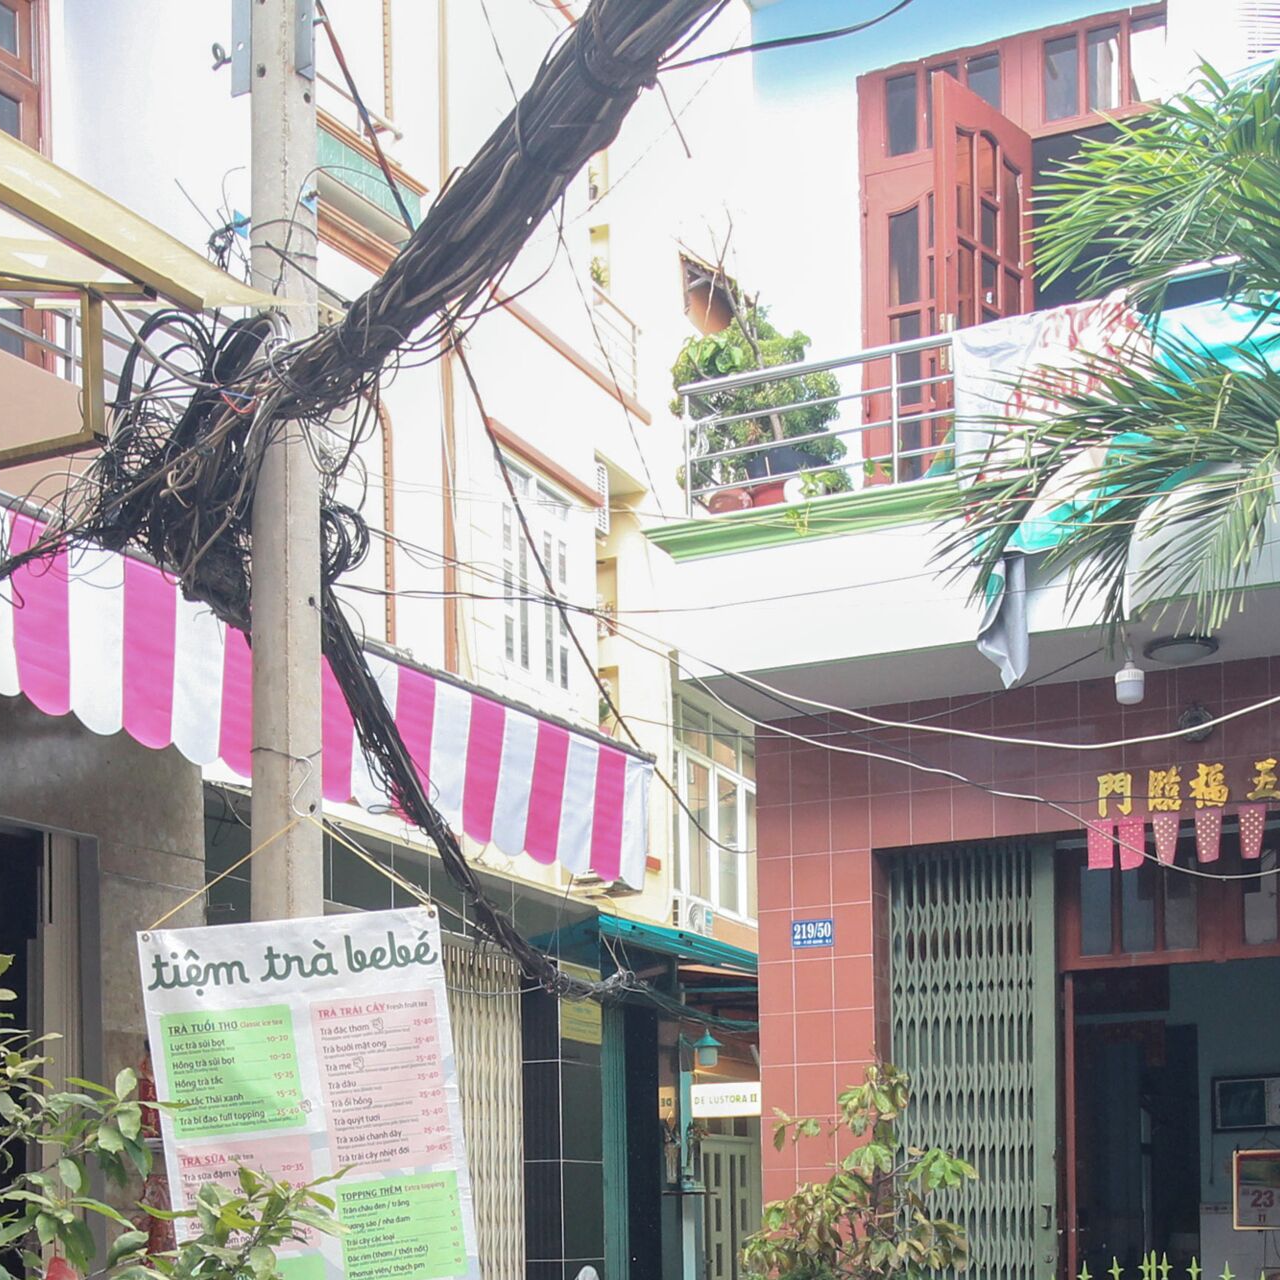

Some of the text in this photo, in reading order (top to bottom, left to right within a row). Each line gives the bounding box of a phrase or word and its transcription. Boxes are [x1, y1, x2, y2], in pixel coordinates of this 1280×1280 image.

[794, 922, 831, 940] 219/50
[148, 931, 437, 996] tiệm trà bebé
[318, 1009, 336, 1017] TRÀ
[340, 1006, 362, 1015] TRÁI
[366, 1002, 385, 1012] CÂY
[168, 1025, 187, 1035] TRÀ
[320, 1027, 332, 1035] Trà
[349, 1023, 369, 1032] thơm
[170, 1042, 183, 1052] Lục
[186, 1040, 197, 1049] trà
[212, 1039, 225, 1048] bọt
[173, 1058, 193, 1071] Hồng
[196, 1058, 207, 1067] trà
[222, 1057, 235, 1065] bọt
[198, 1077, 209, 1086] trà
[224, 1093, 243, 1101] xanh
[180, 1116, 192, 1125] Trà
[203, 1114, 217, 1123] đao
[235, 1109, 265, 1120] topping
[336, 1136, 348, 1144] Trà
[367, 1132, 388, 1141] chanh
[184, 1173, 196, 1181] Trà
[341, 1189, 377, 1200] TOPPING
[1250, 1190, 1274, 1208] 23
[375, 1201, 386, 1210] đen
[349, 1270, 373, 1278] Phomai
